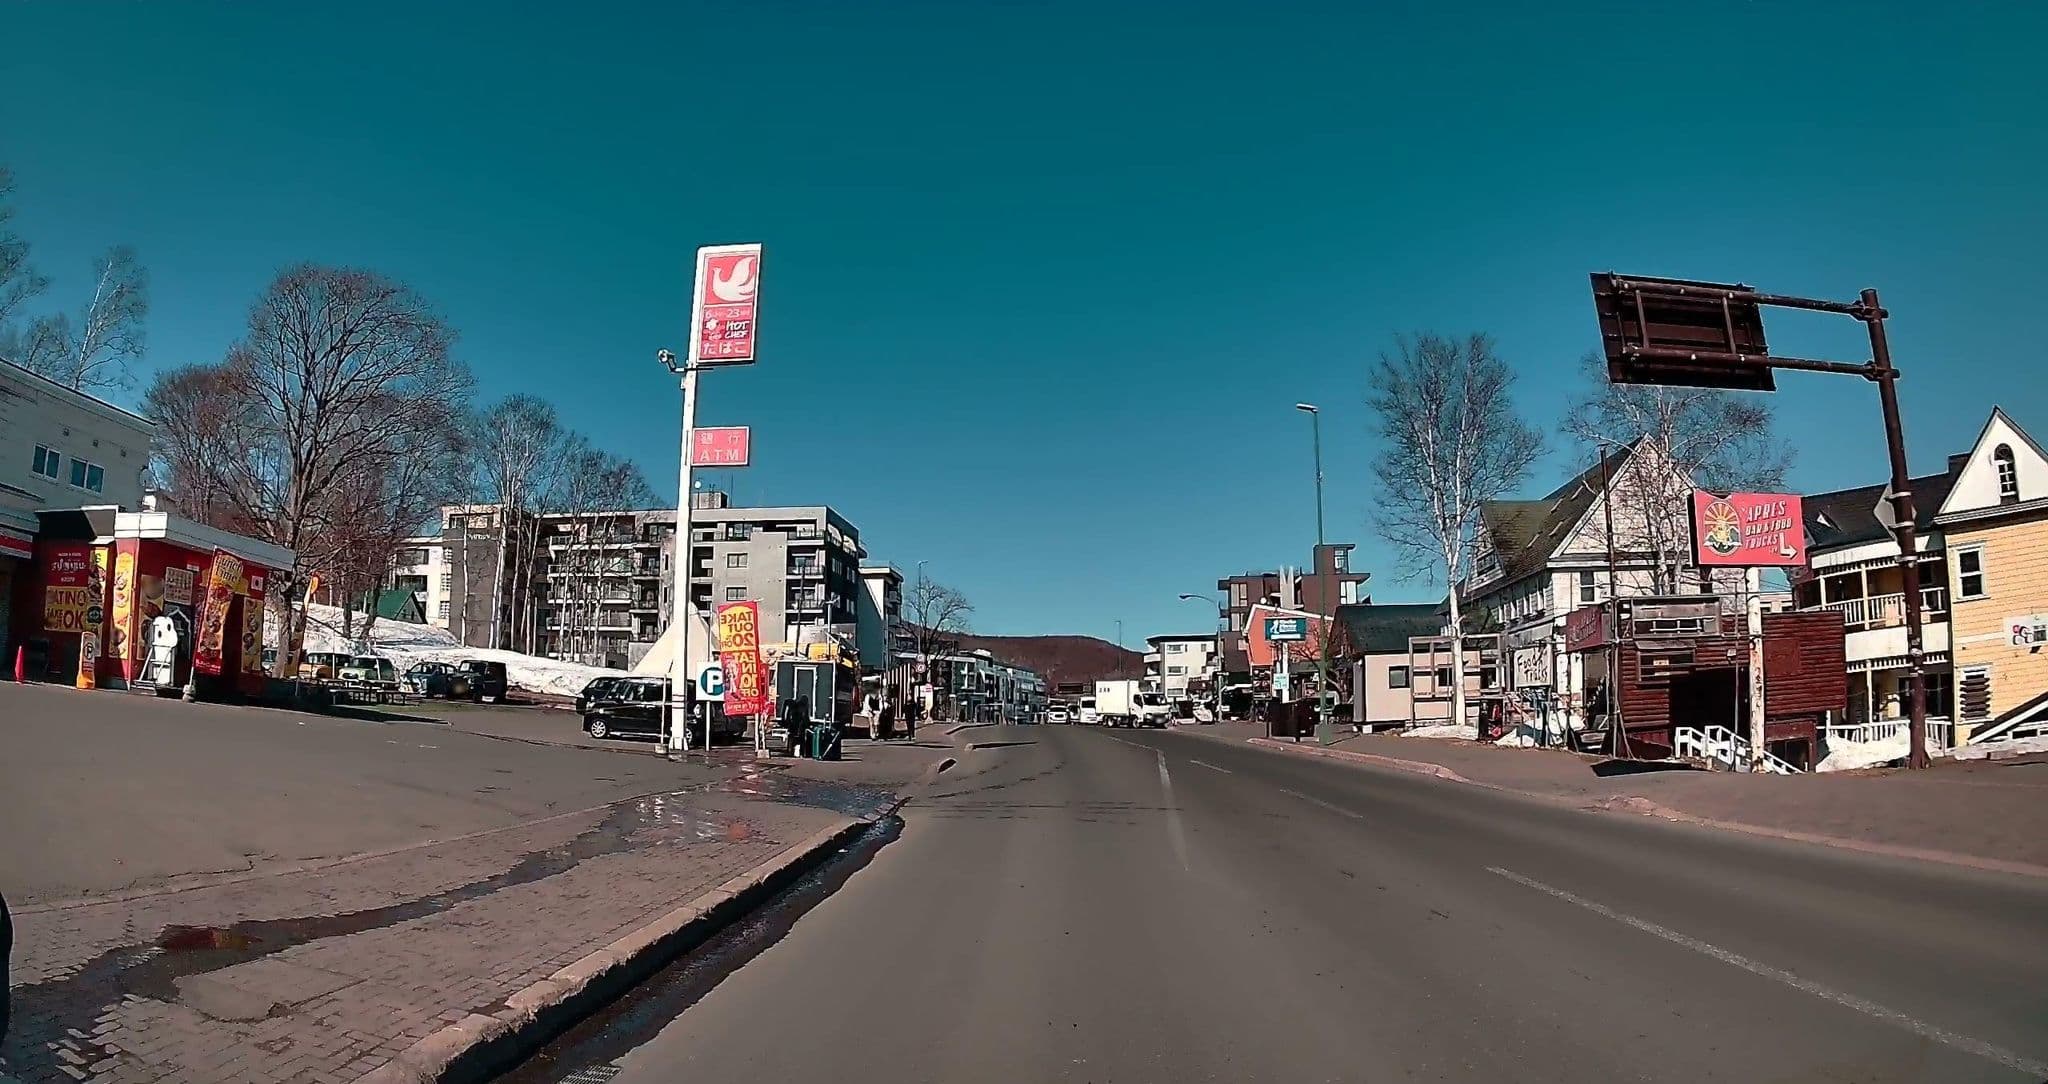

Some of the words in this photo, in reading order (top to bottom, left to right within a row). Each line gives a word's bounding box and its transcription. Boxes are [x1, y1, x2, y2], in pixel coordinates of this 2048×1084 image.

[726, 320, 750, 331] HOT
[724, 331, 748, 339] CHEF
[703, 340, 747, 355] たばこ
[699, 448, 740, 462] ATM
[1745, 533, 1779, 549] TRUCKS
[64, 610, 84, 630] OK
[707, 670, 724, 694] P
